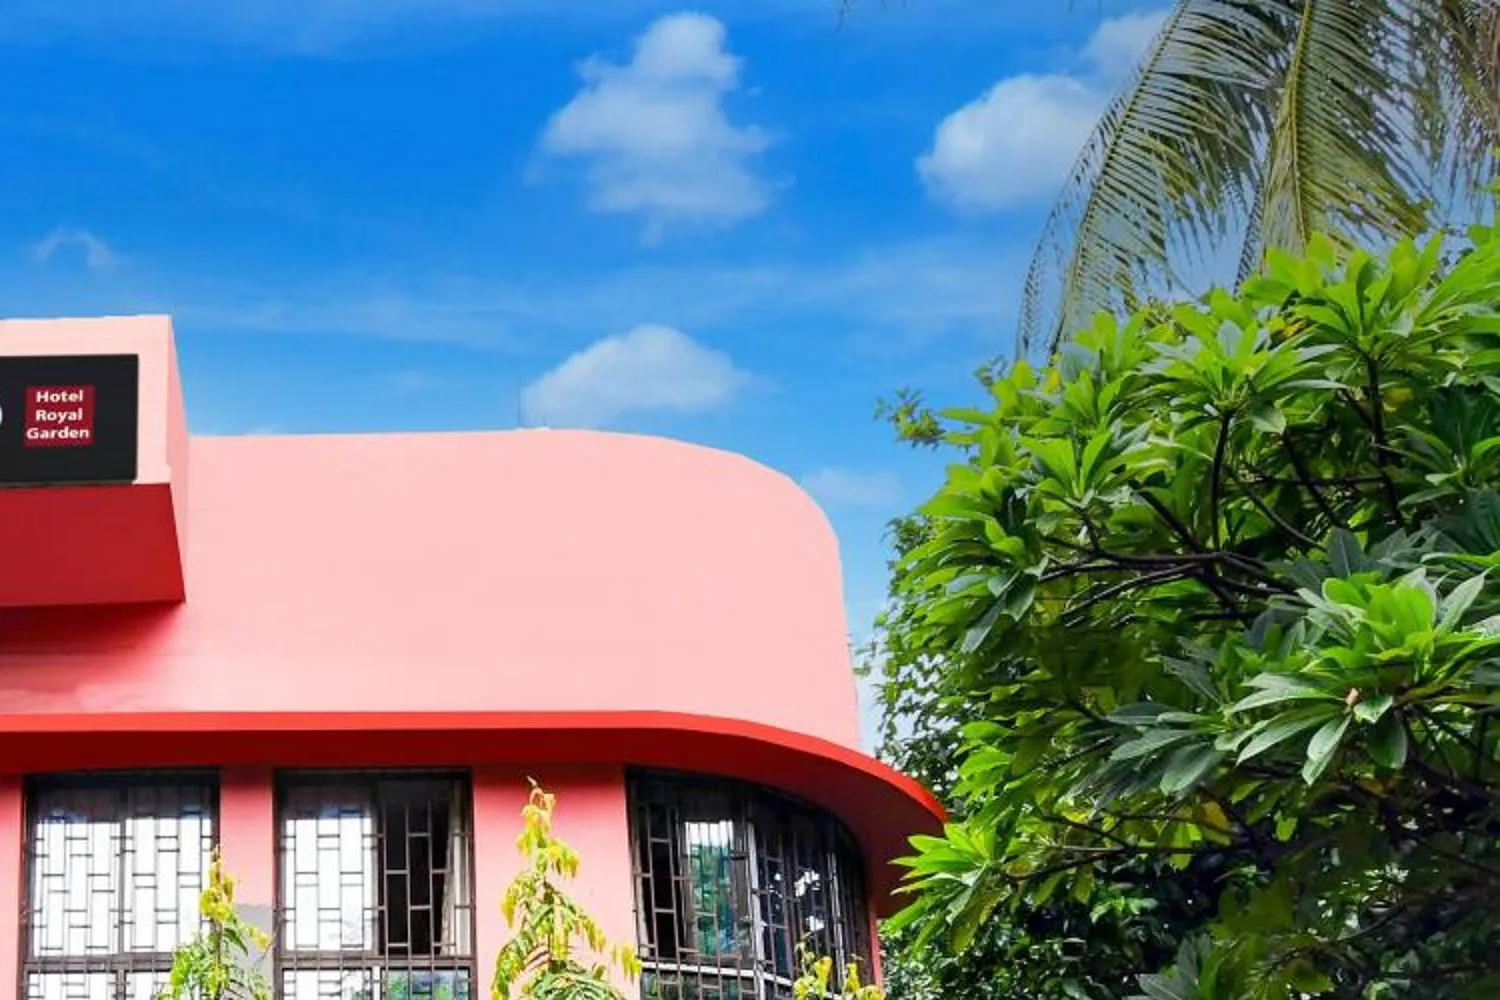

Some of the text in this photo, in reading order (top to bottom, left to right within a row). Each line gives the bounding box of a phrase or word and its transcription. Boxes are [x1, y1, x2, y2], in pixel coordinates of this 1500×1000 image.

[36, 389, 83, 403] Hotel
[35, 407, 83, 425] Royal
[26, 426, 90, 439] Garden
